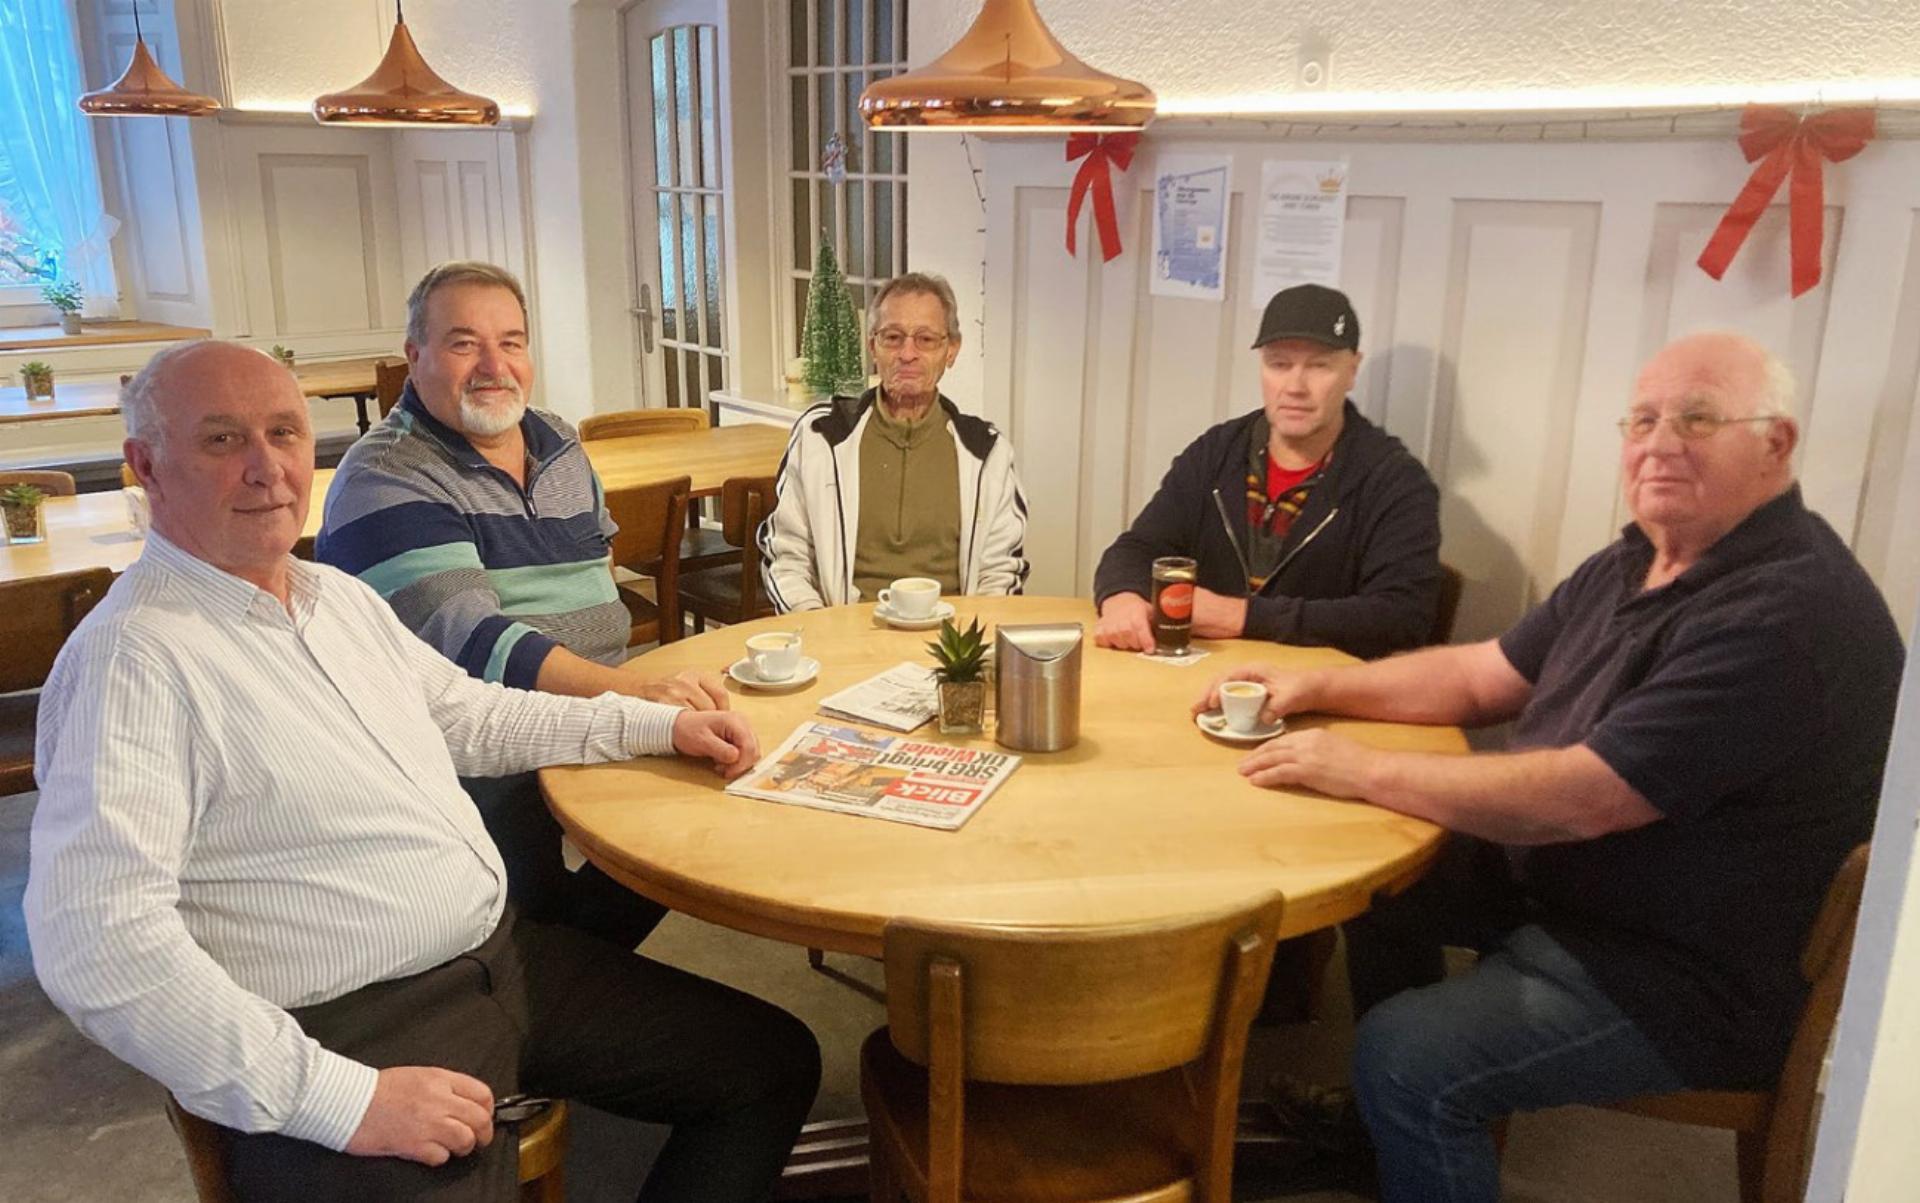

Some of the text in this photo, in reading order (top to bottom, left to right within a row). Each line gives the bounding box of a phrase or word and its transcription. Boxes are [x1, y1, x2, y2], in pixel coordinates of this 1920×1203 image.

[878, 752, 947, 773] bringt
[948, 761, 998, 779] SRG
[895, 782, 974, 803] Blick
